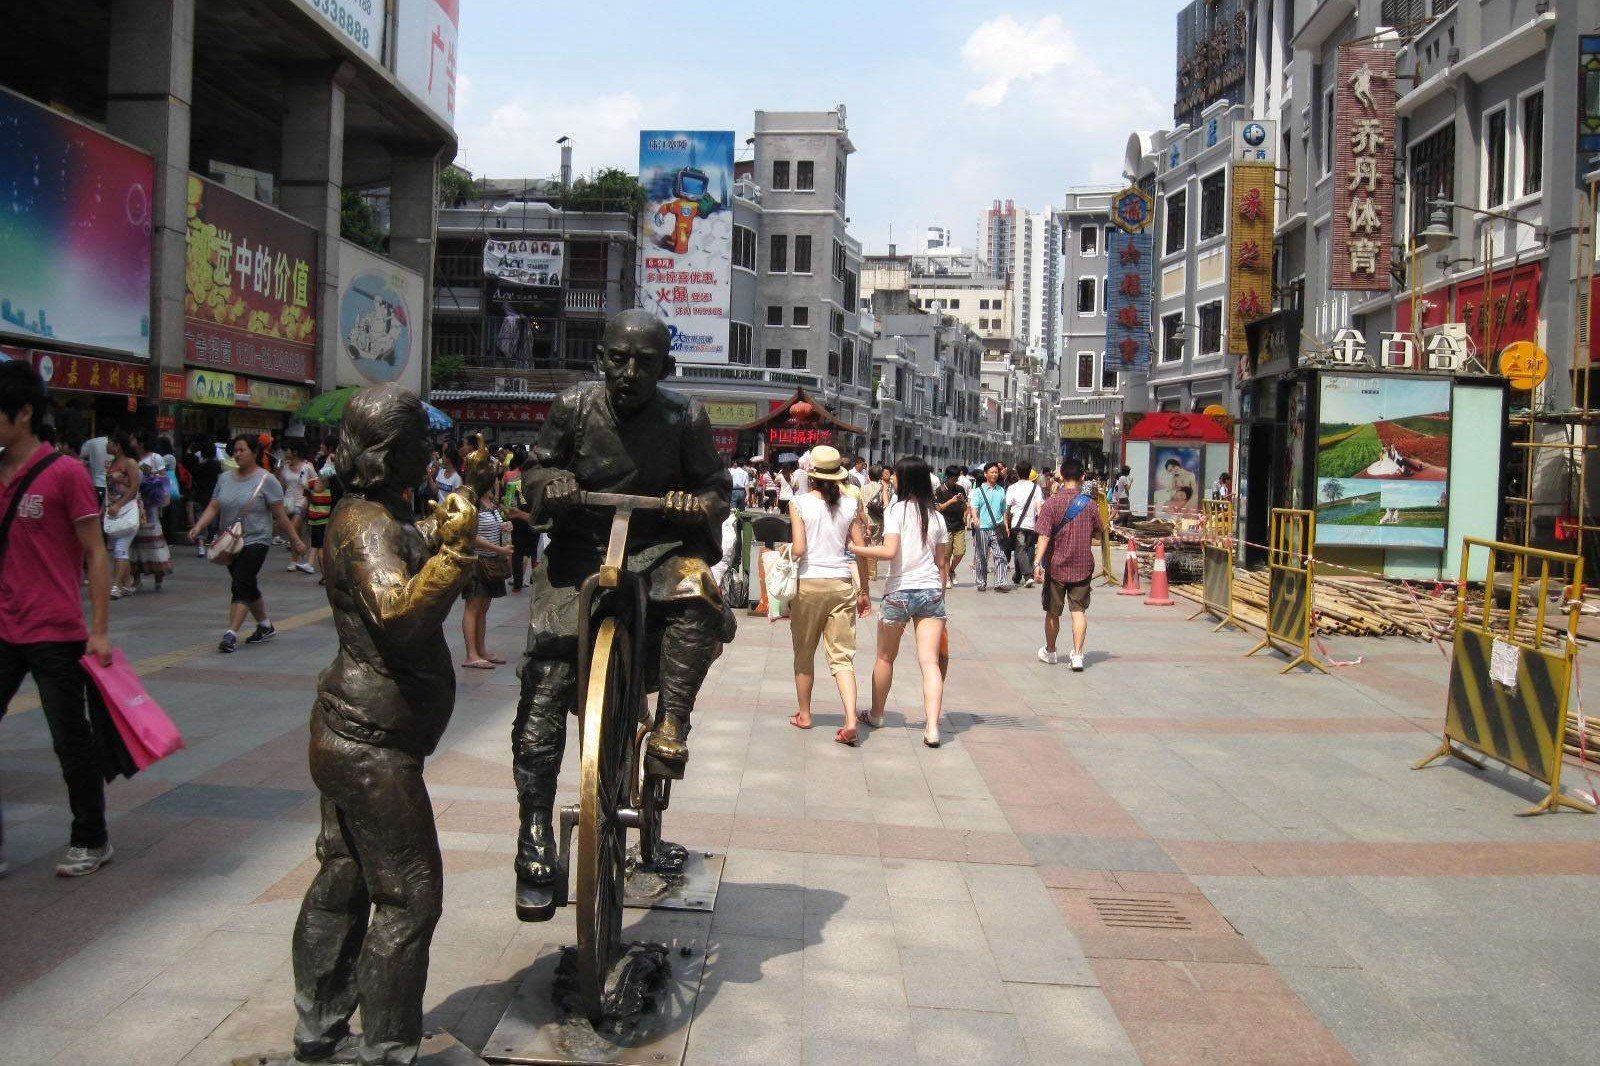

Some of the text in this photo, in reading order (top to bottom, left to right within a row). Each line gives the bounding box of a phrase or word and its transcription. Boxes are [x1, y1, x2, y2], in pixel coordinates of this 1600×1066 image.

[1346, 119, 1384, 275] 乔丹体育
[1332, 329, 1462, 370] 金百合
